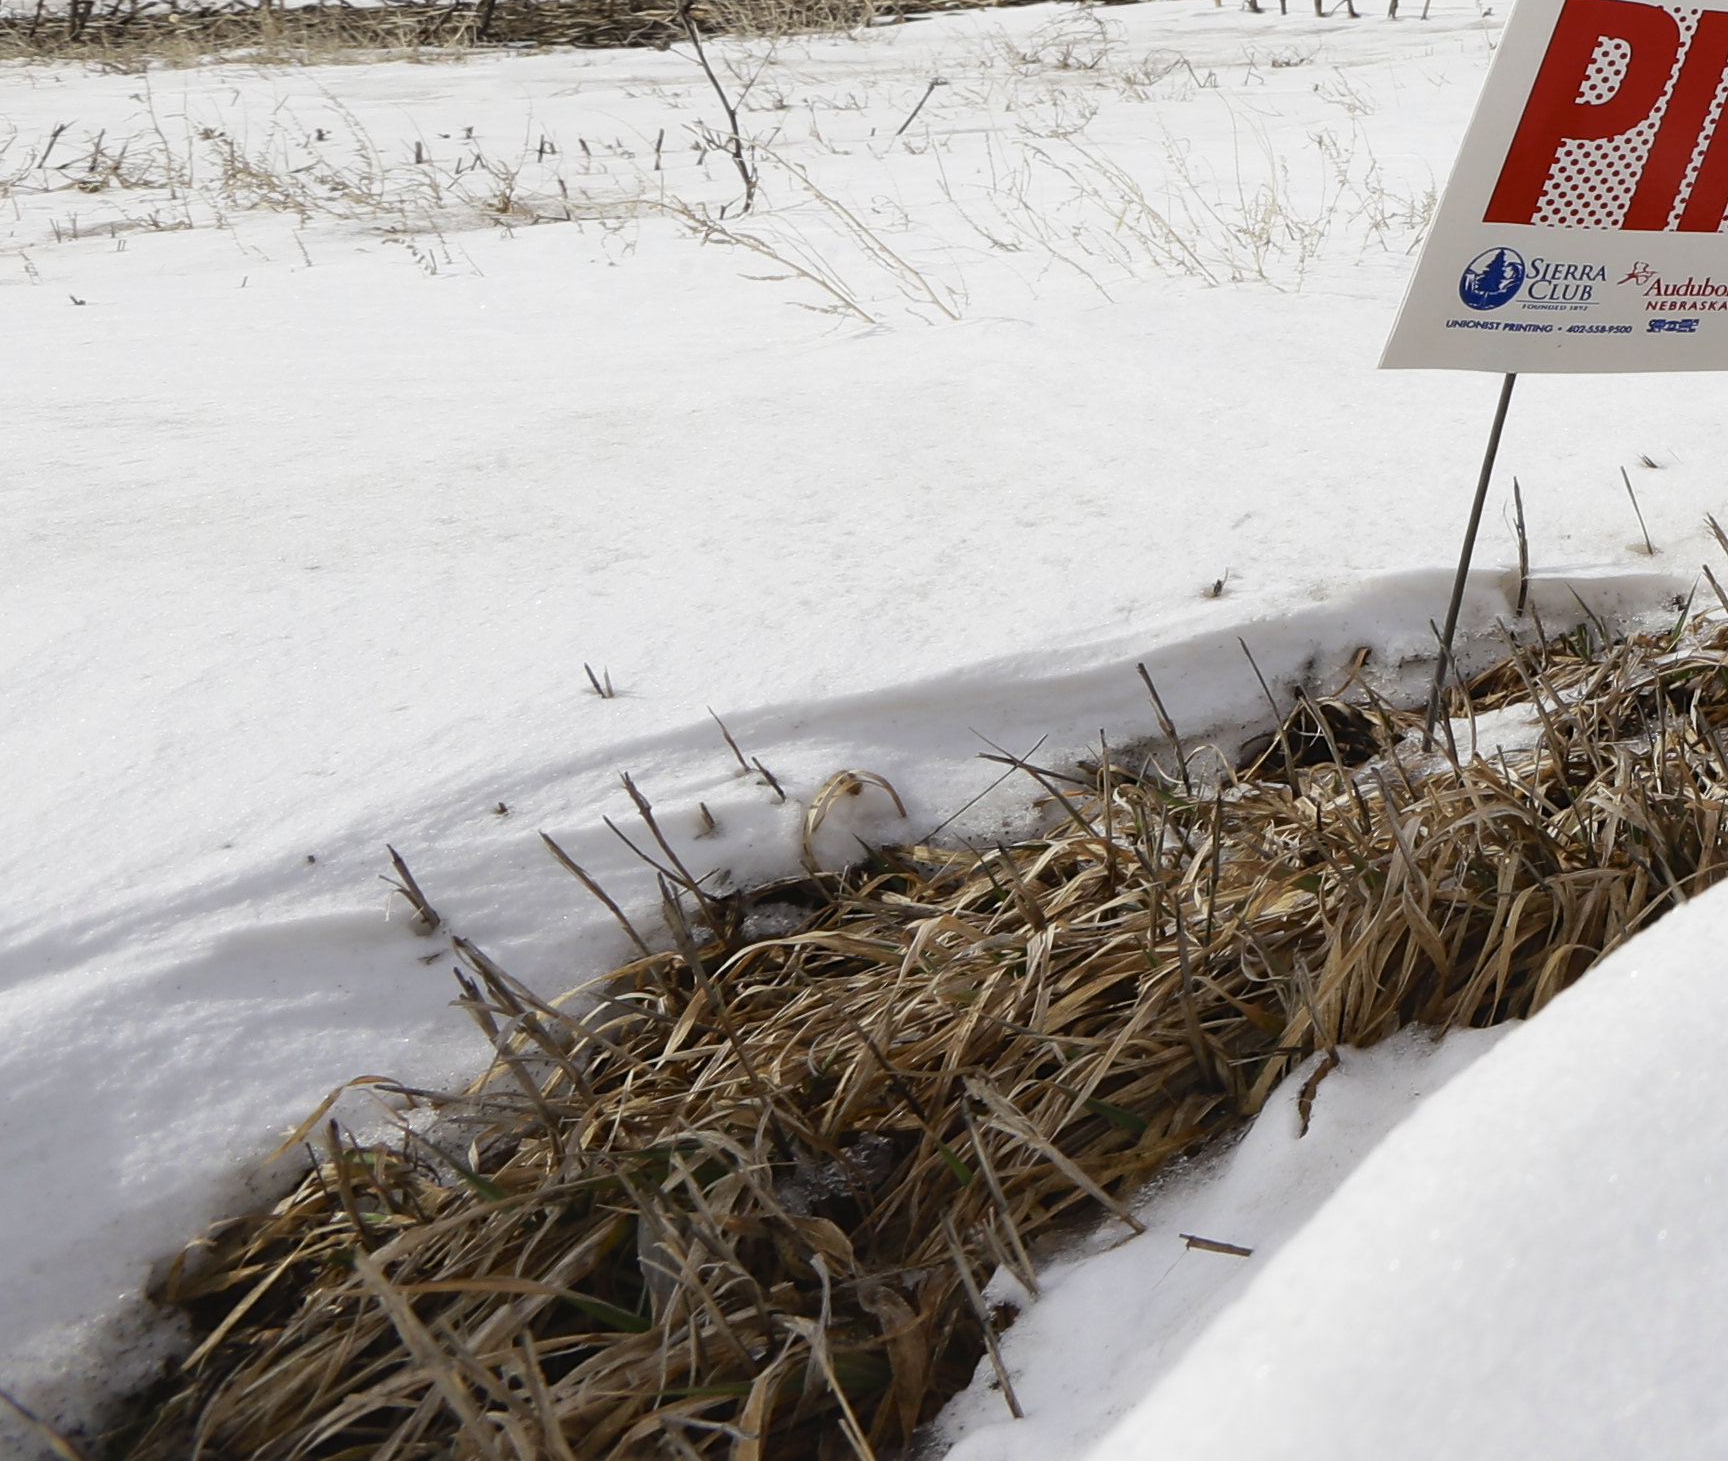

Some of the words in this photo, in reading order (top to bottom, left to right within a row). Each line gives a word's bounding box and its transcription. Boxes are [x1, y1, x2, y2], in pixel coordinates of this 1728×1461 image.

[1526, 257, 1607, 282] SIERRA
[1527, 279, 1593, 301] CLUB
[1521, 303, 1567, 311] FOUNDED
[1445, 320, 1501, 332] UNIONIST
[1502, 323, 1553, 334] PRINTING
